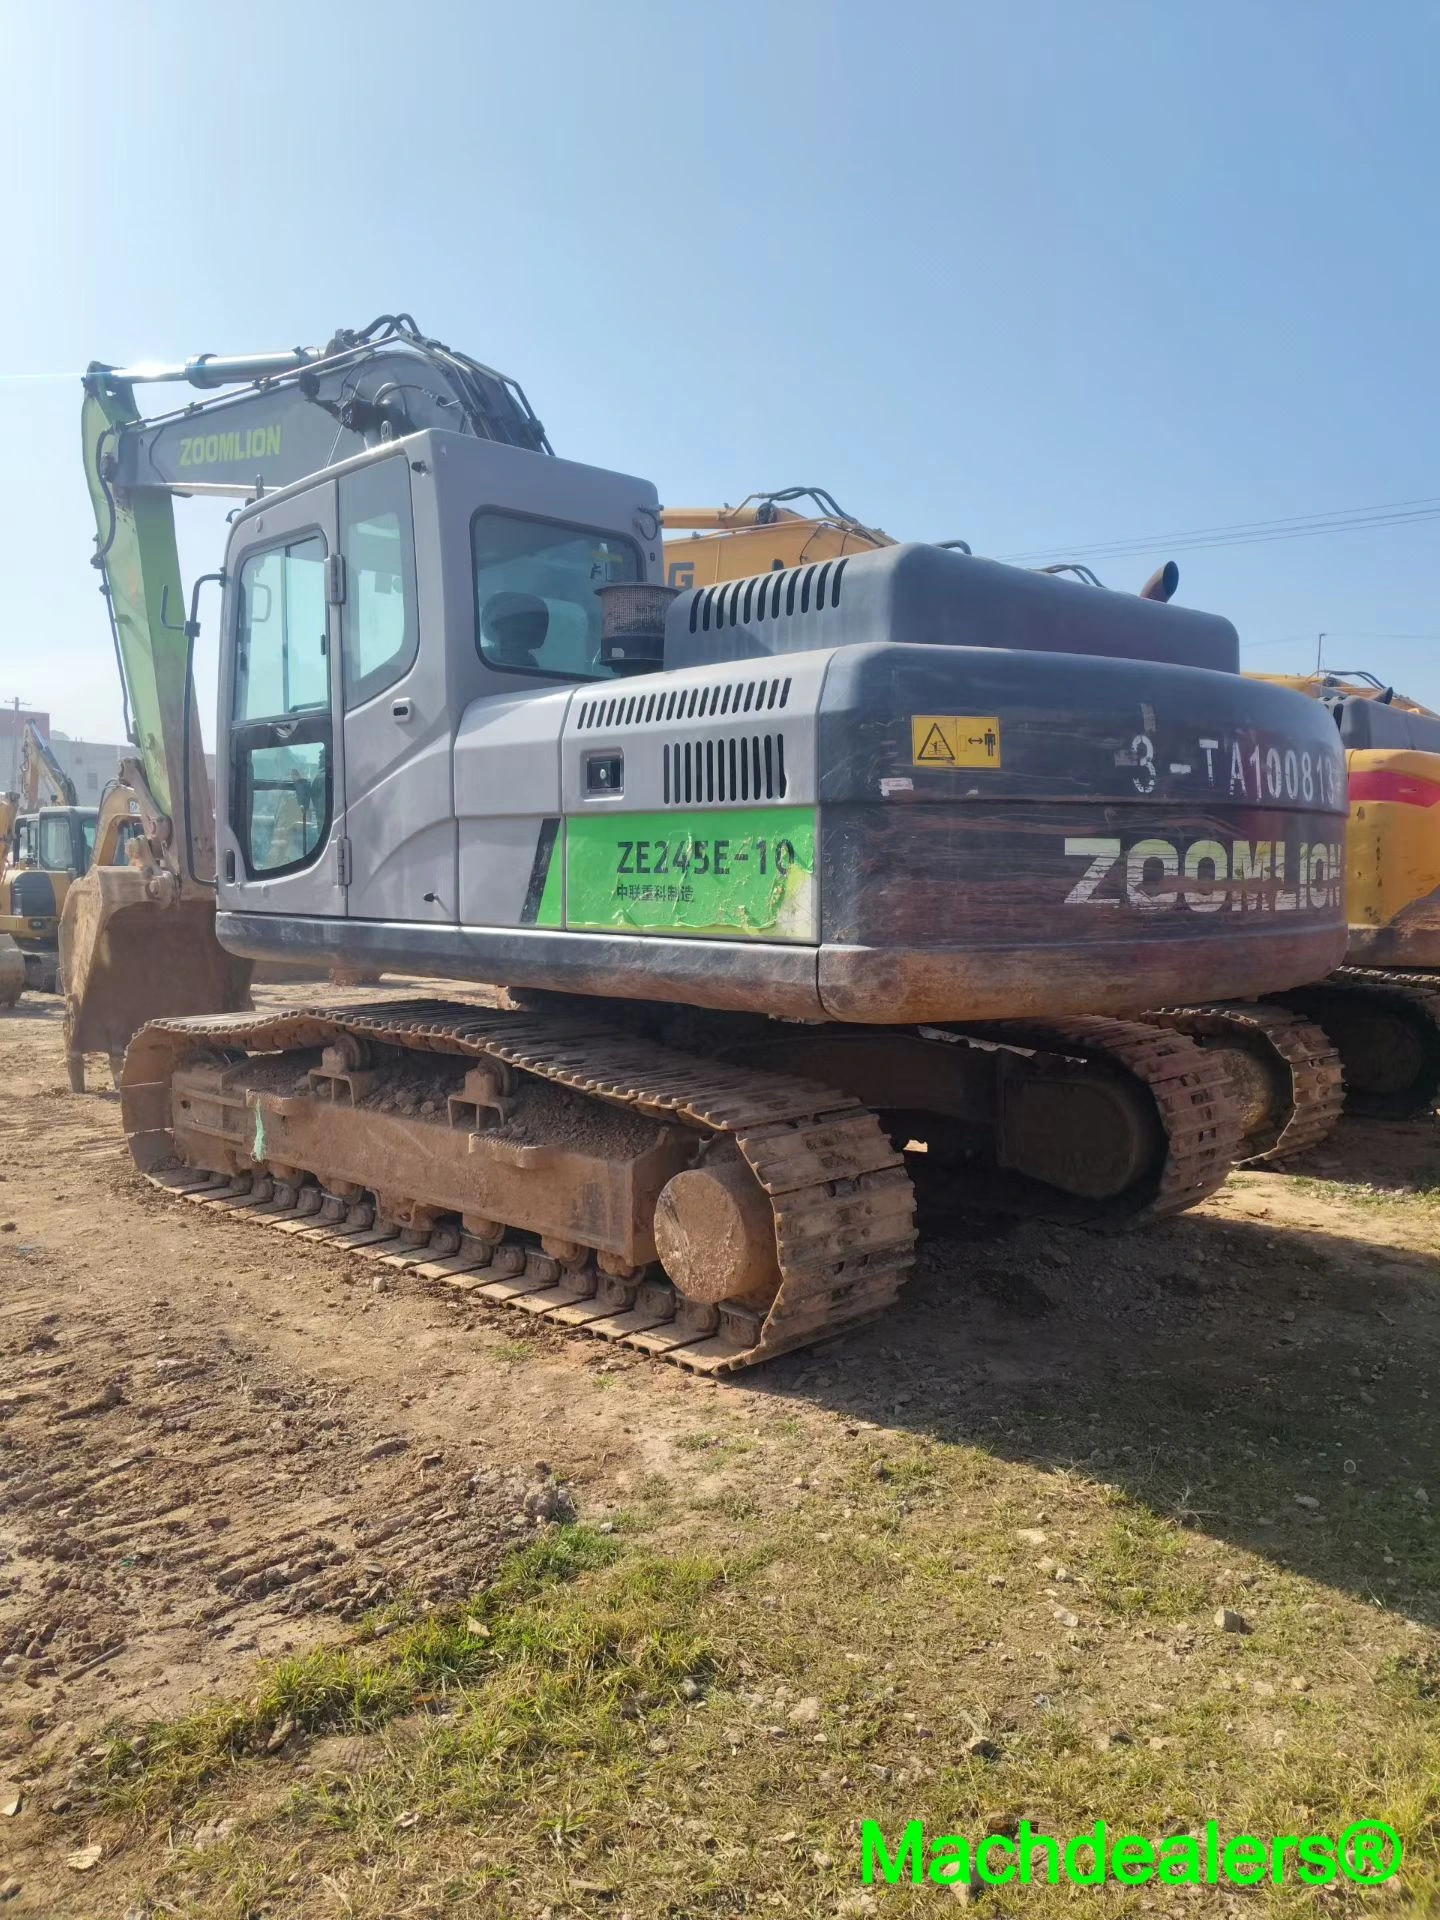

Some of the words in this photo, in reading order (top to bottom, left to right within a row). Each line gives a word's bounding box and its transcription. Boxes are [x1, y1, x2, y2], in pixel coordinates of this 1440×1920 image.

[180, 424, 282, 466] ZOOMLION
[617, 839, 795, 877] ZE245E-10
[1064, 837, 1341, 913] ZOOMLION
[617, 884, 694, 903] 中联重科制造
